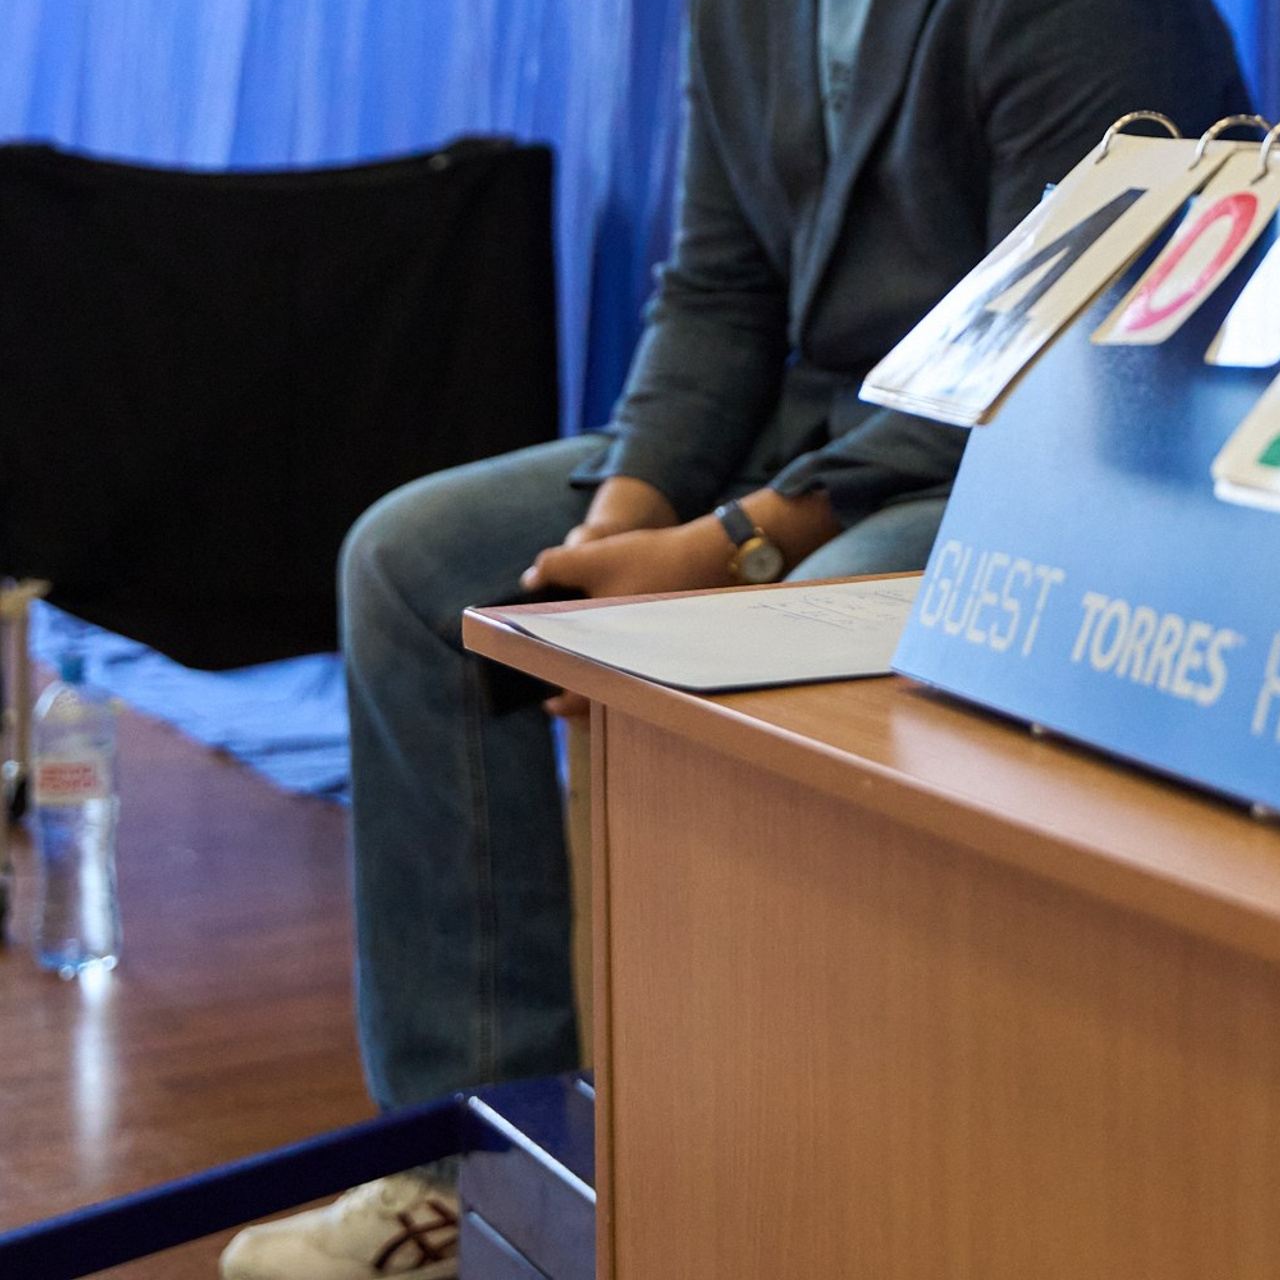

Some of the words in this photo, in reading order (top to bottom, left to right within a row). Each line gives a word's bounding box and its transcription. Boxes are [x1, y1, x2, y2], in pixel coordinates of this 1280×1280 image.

[1121, 193, 1258, 333] 0
[919, 539, 1066, 658] GUEST
[1071, 590, 1236, 707] TORRES
